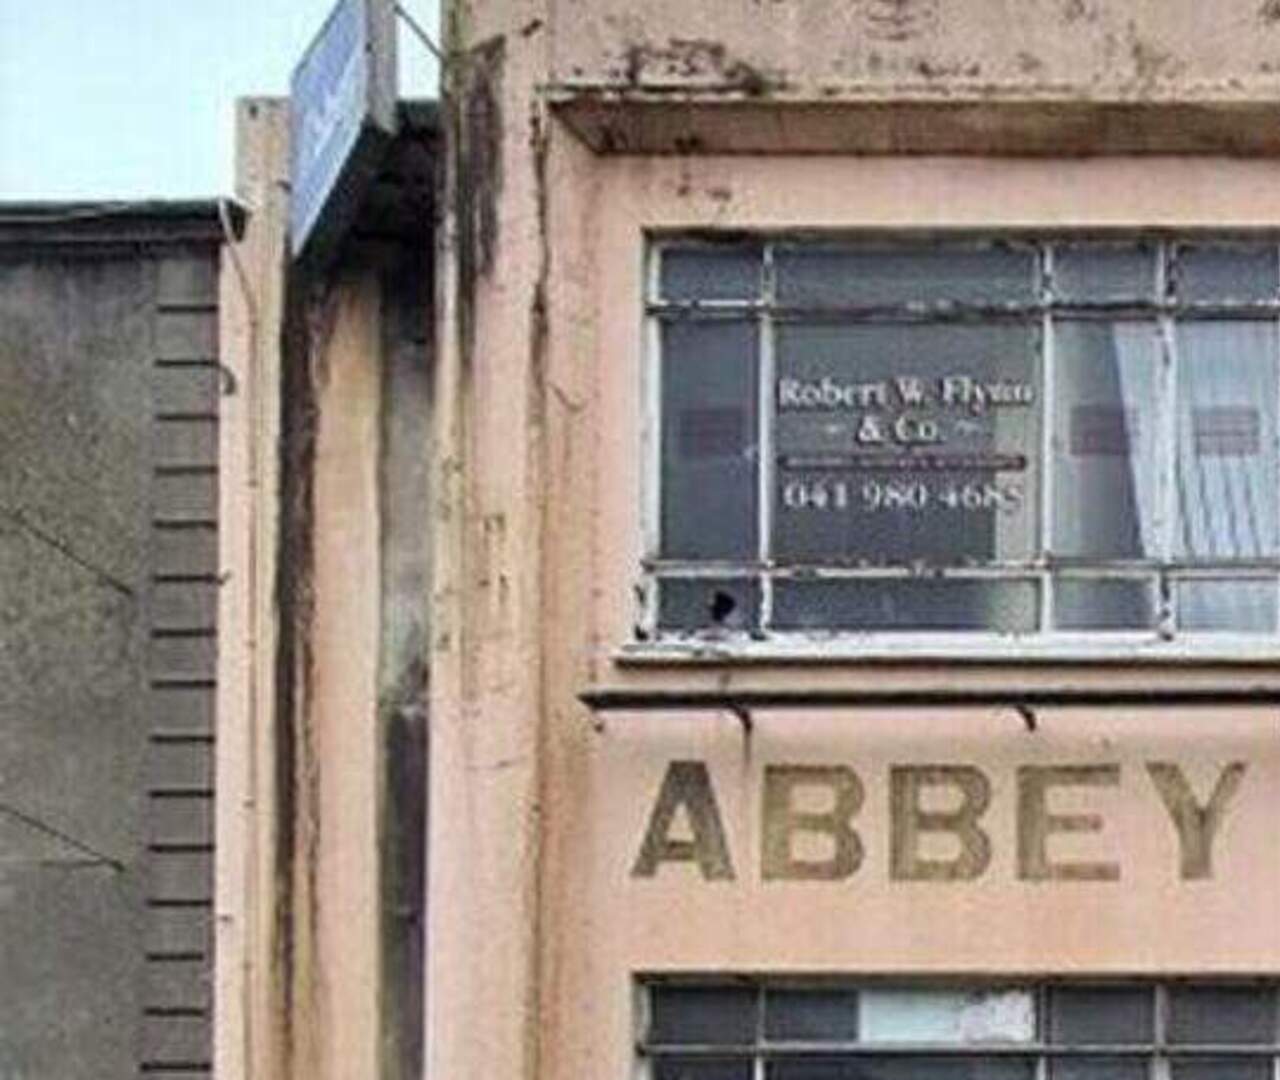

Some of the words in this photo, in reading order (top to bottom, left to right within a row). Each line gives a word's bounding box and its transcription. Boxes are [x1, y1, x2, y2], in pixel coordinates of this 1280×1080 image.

[778, 376, 887, 409] Robert
[941, 375, 1034, 417] Flynn
[856, 414, 884, 446] &
[783, 482, 847, 508] 041
[861, 479, 928, 510] 980
[630, 759, 1248, 882] ABBEY
